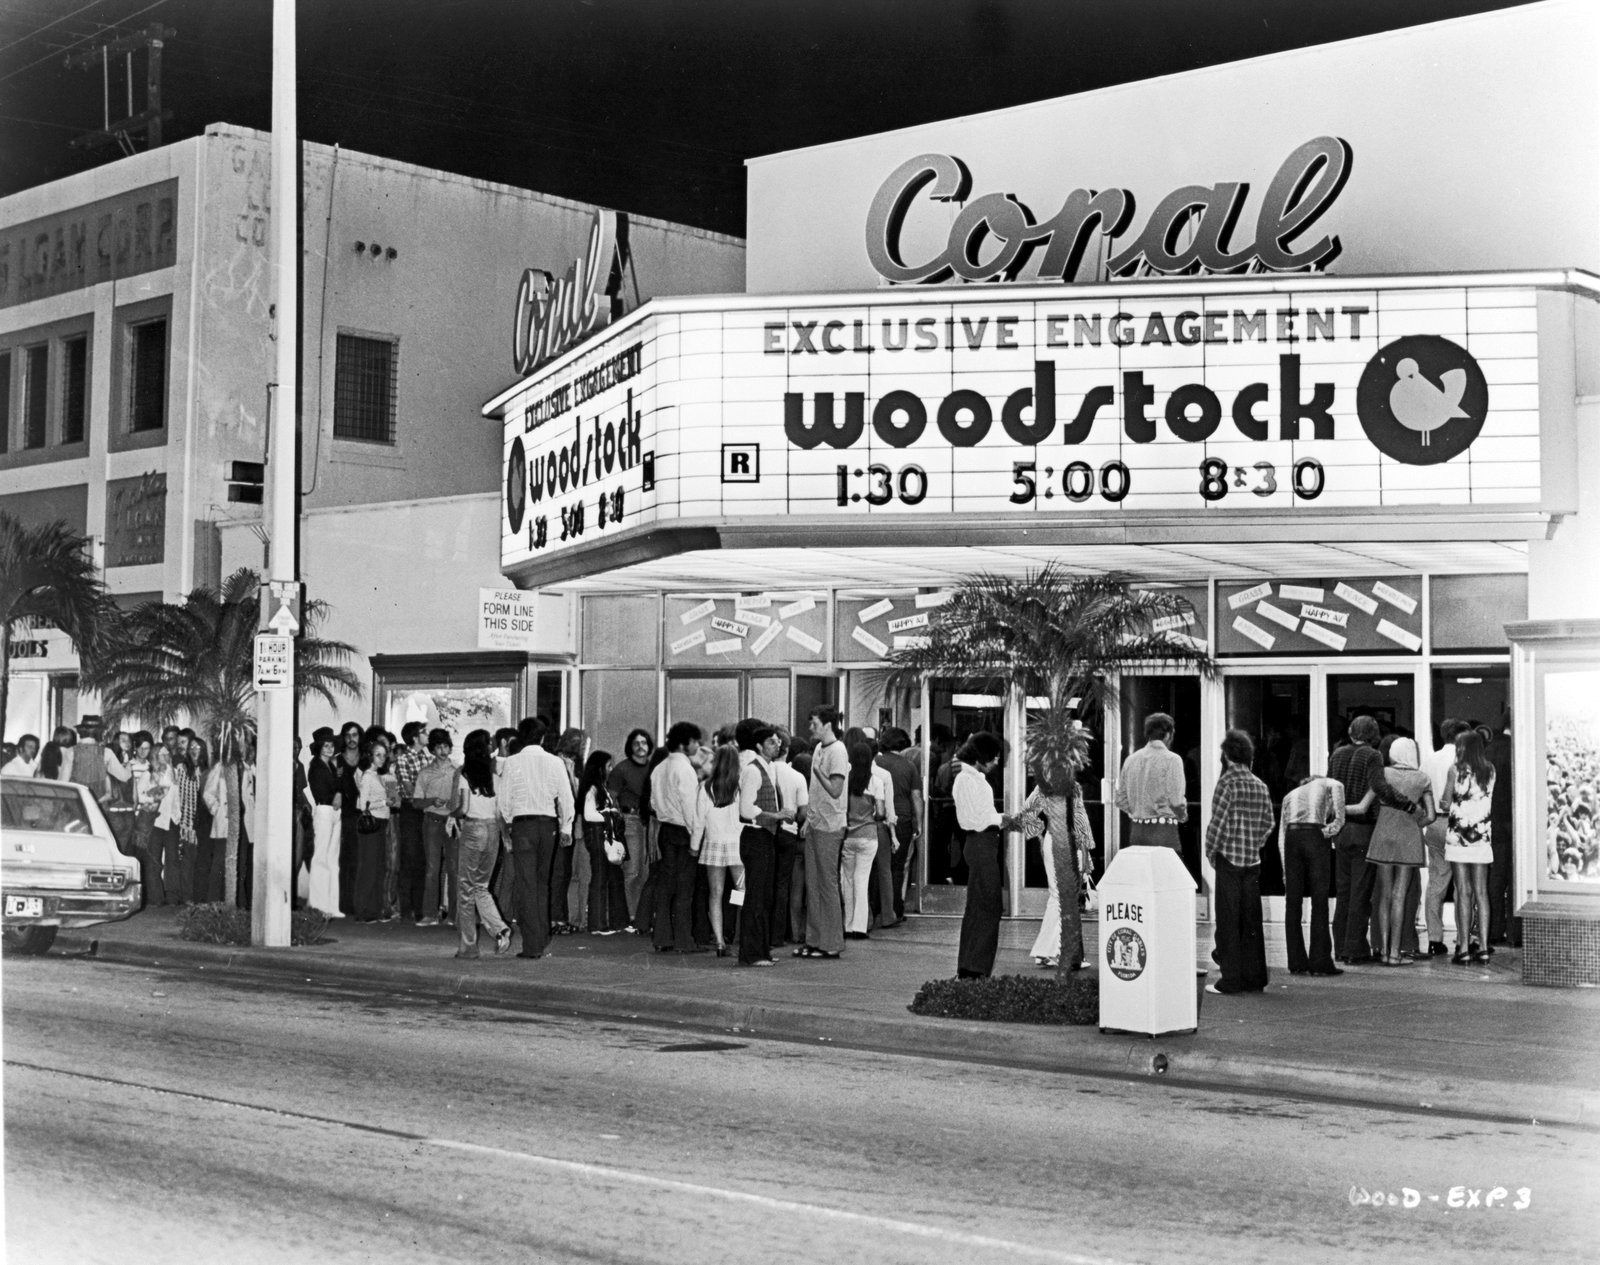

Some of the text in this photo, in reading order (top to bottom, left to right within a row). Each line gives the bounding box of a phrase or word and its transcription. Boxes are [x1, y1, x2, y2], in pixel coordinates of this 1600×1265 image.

[865, 136, 1352, 283] Coral
[513, 208, 616, 375] Coral
[763, 304, 1370, 356] EXCLUSIVE ENGAGEMENT
[524, 341, 643, 435] EXCLUSIVE ENGAGEMENT
[784, 354, 1335, 450] woodstock
[530, 388, 642, 504] woodstock
[730, 452, 751, 475] R
[836, 456, 1325, 508] 1:30 5:00 8:30
[483, 602, 535, 617] FORM LINE
[495, 591, 522, 601] PLEASE
[1304, 608, 1330, 619] HAPPY
[483, 617, 535, 632] THIS SIDE
[268, 643, 286, 654] HOUR
[1106, 902, 1144, 923] PLEASE
